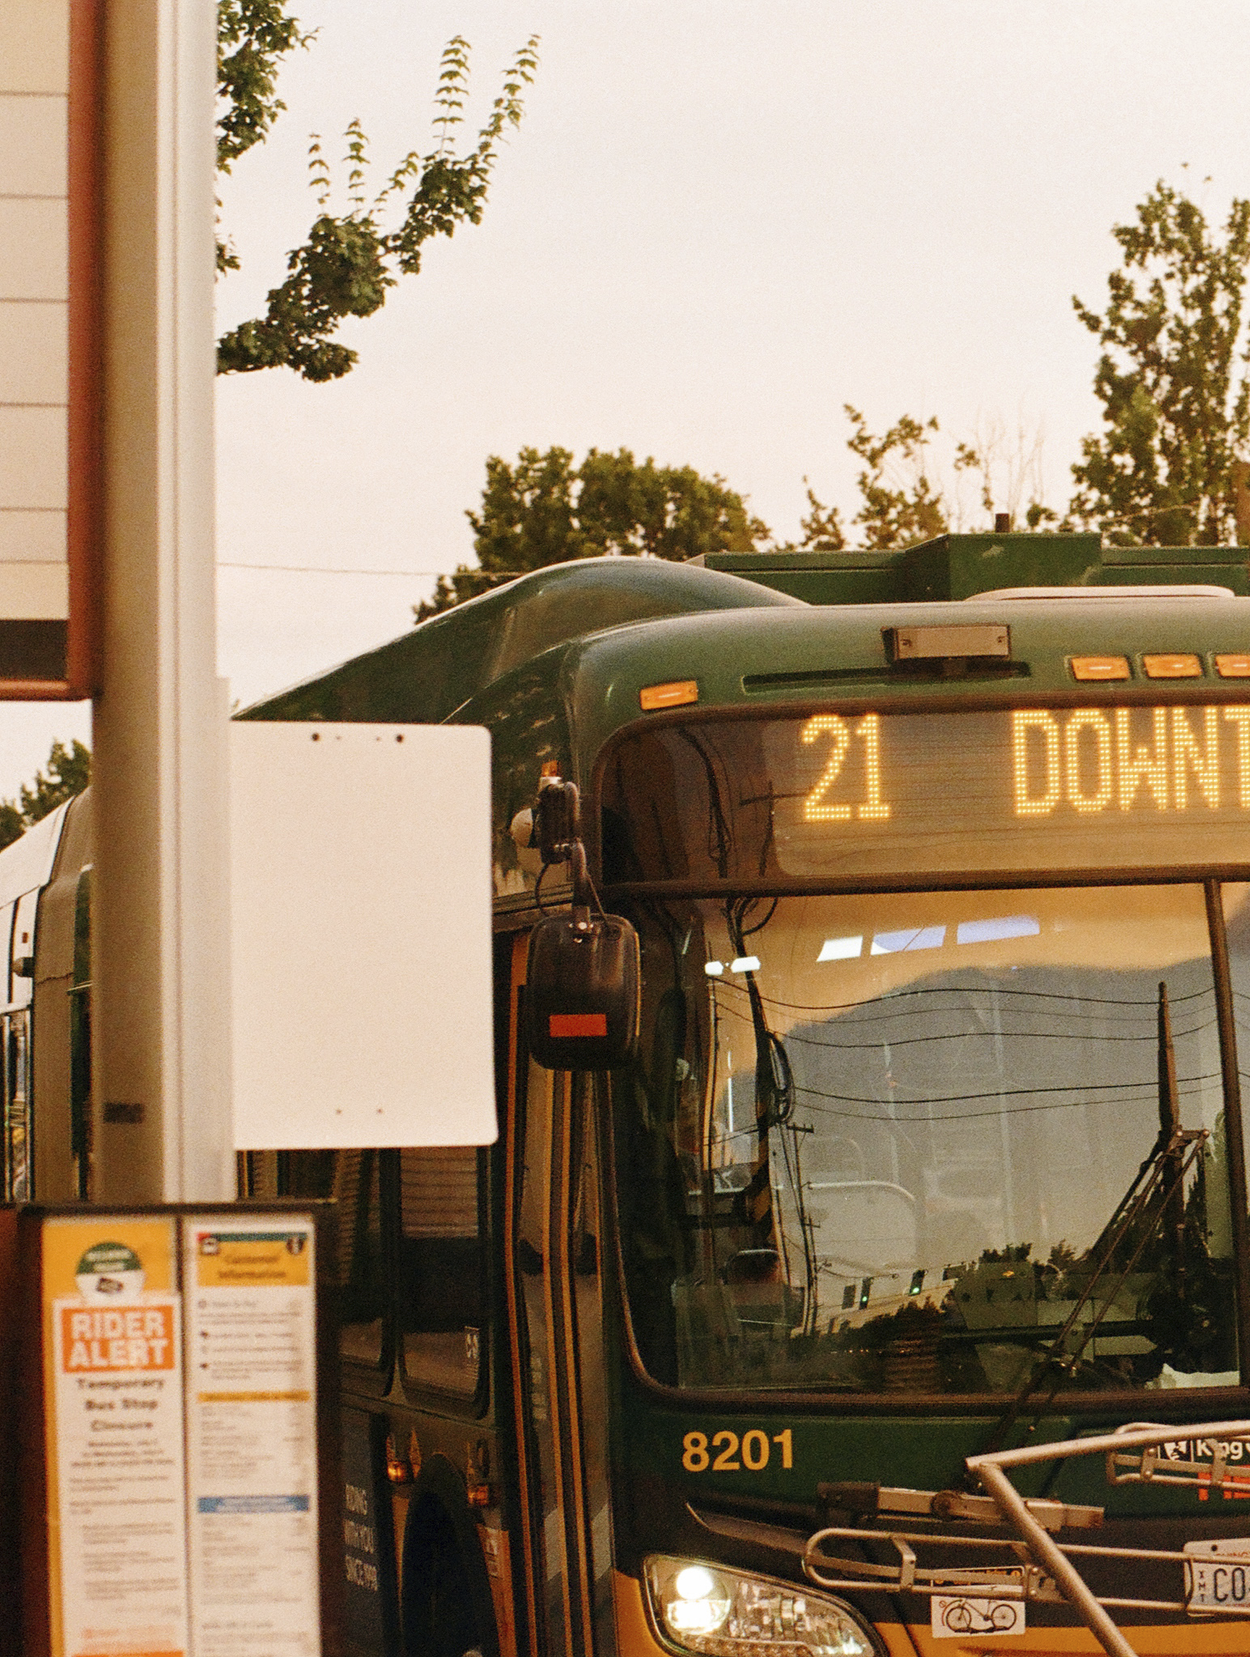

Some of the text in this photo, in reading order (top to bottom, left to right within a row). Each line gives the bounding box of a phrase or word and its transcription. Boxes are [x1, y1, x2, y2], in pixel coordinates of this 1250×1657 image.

[801, 713, 890, 822] 21
[70, 1311, 164, 1338] RIDER
[69, 1338, 169, 1368] ALERT
[682, 1429, 793, 1472] 8201
[1196, 1438, 1243, 1460] Kng
